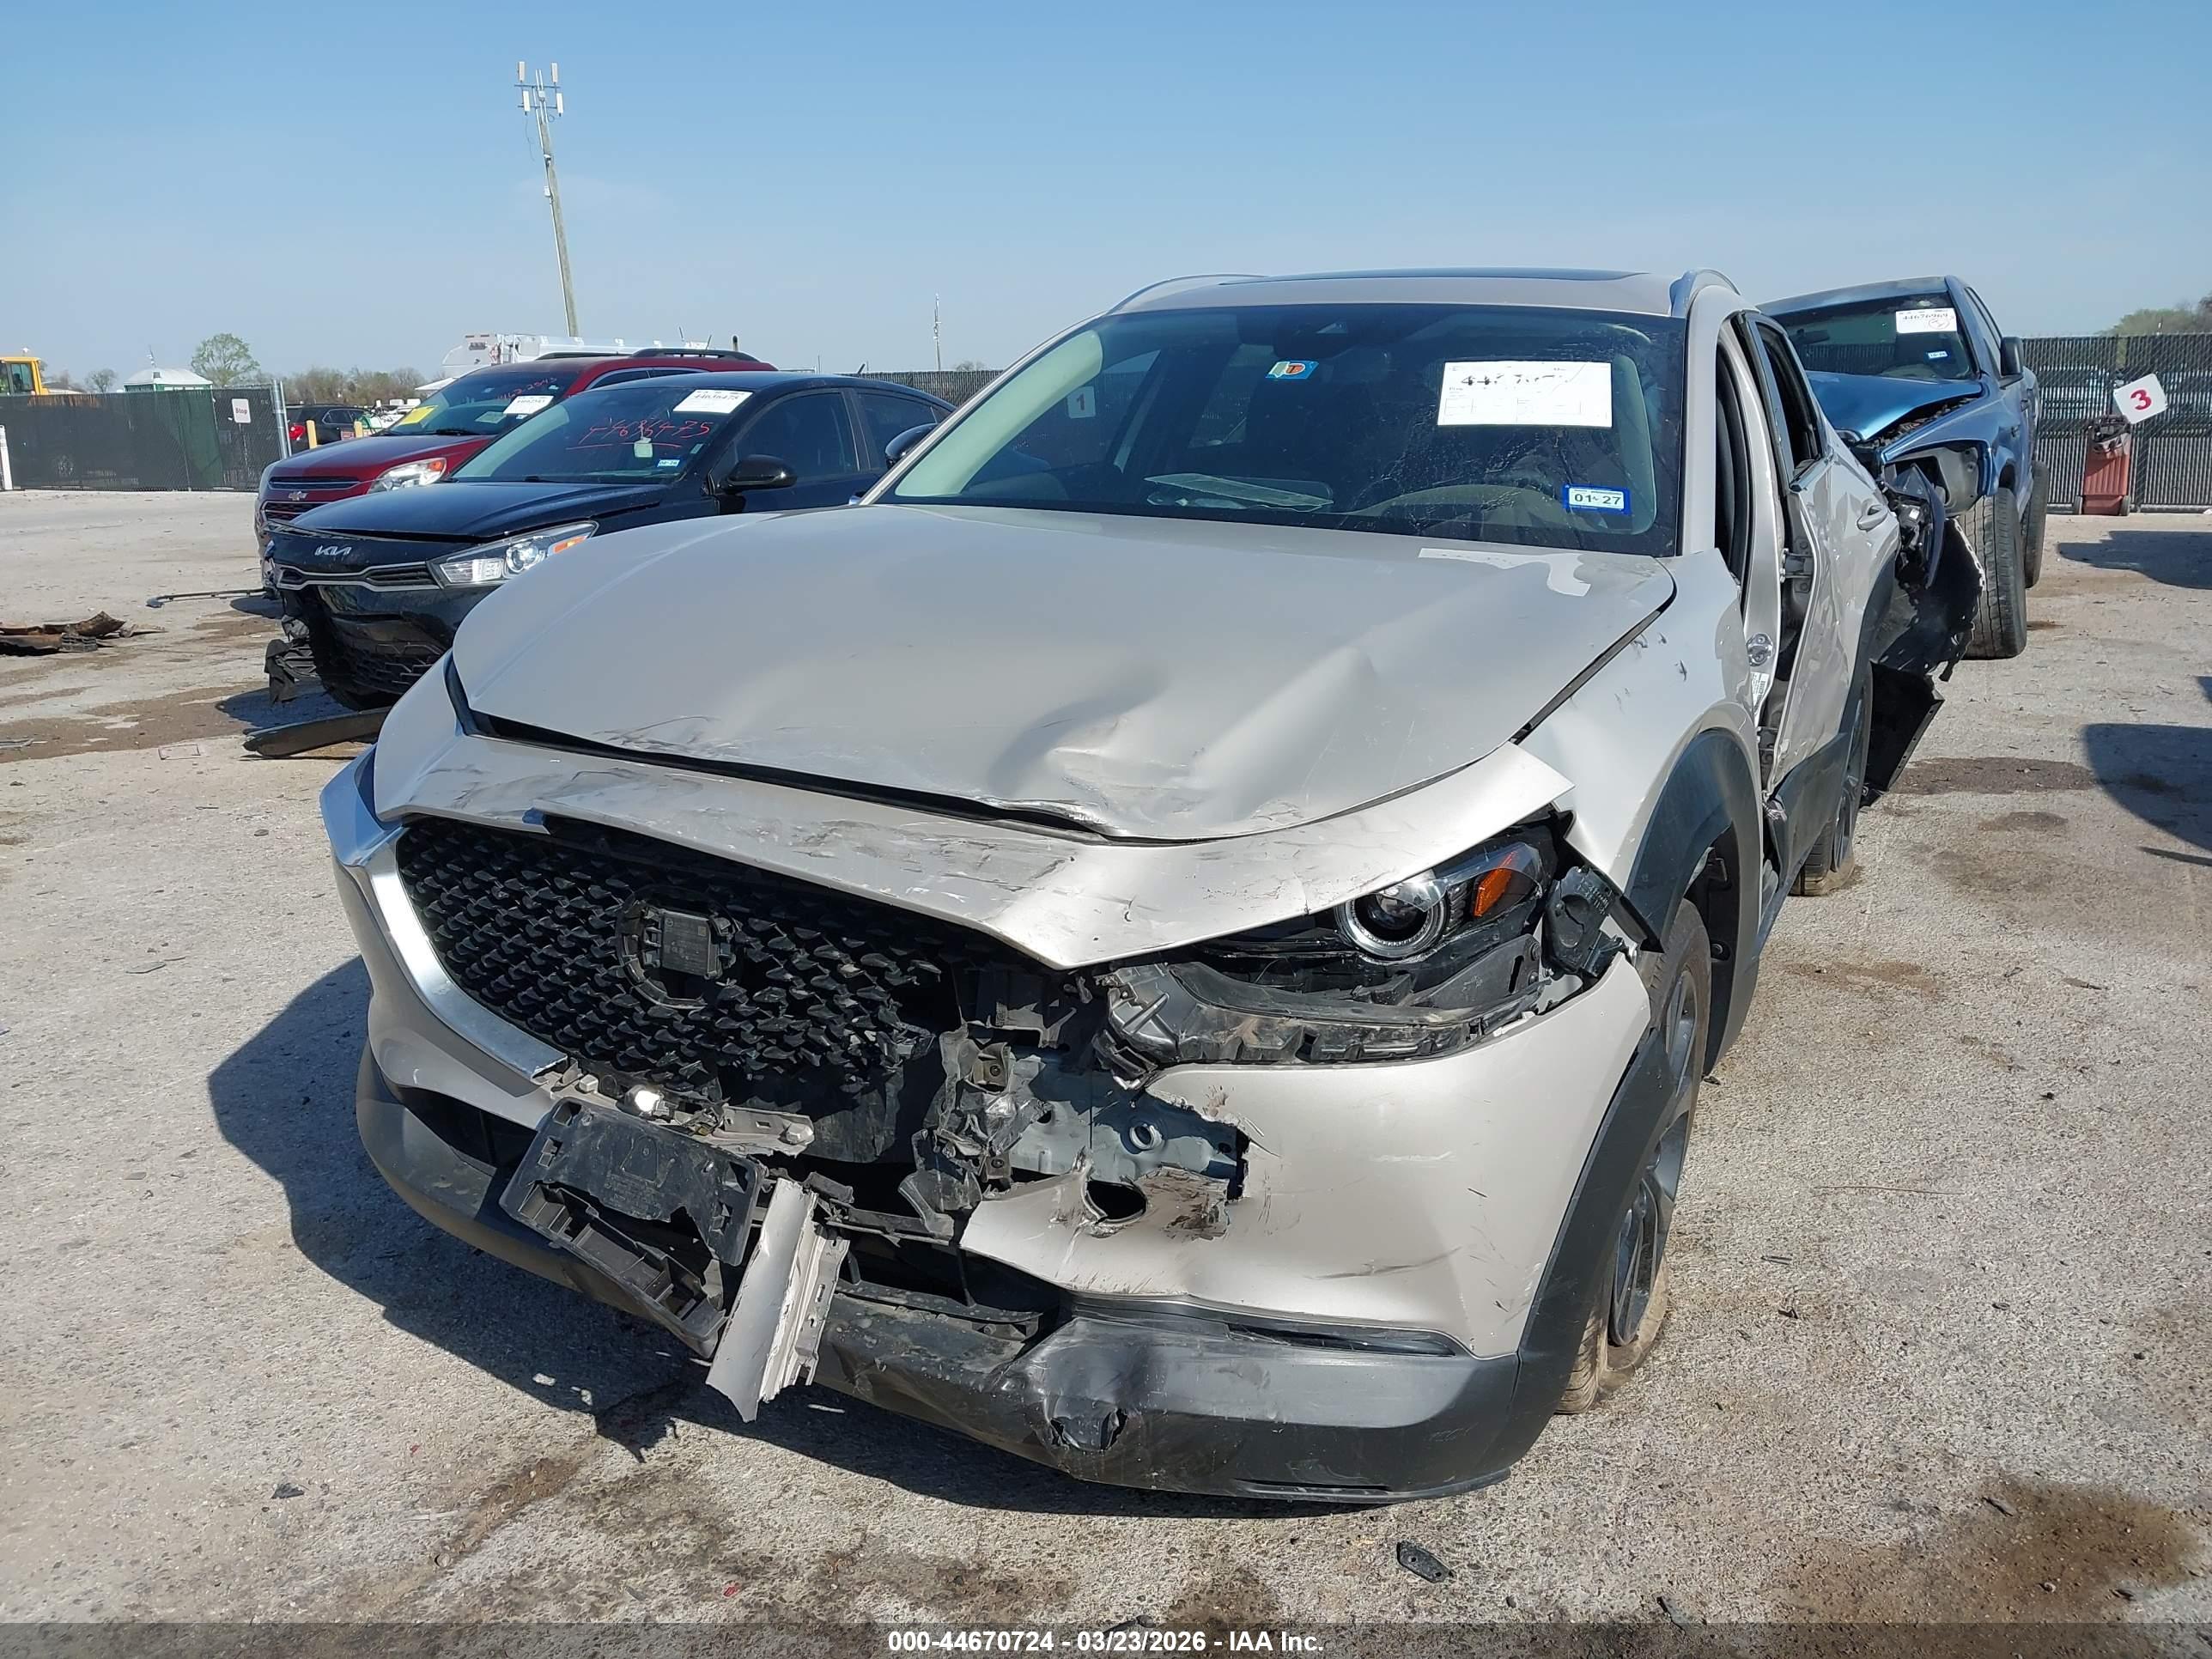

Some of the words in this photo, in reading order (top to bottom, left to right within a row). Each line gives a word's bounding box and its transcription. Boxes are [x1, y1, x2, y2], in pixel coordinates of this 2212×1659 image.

[1076, 393, 1085, 411] 1
[2130, 389, 2152, 410] 3
[314, 545, 352, 556] KIA
